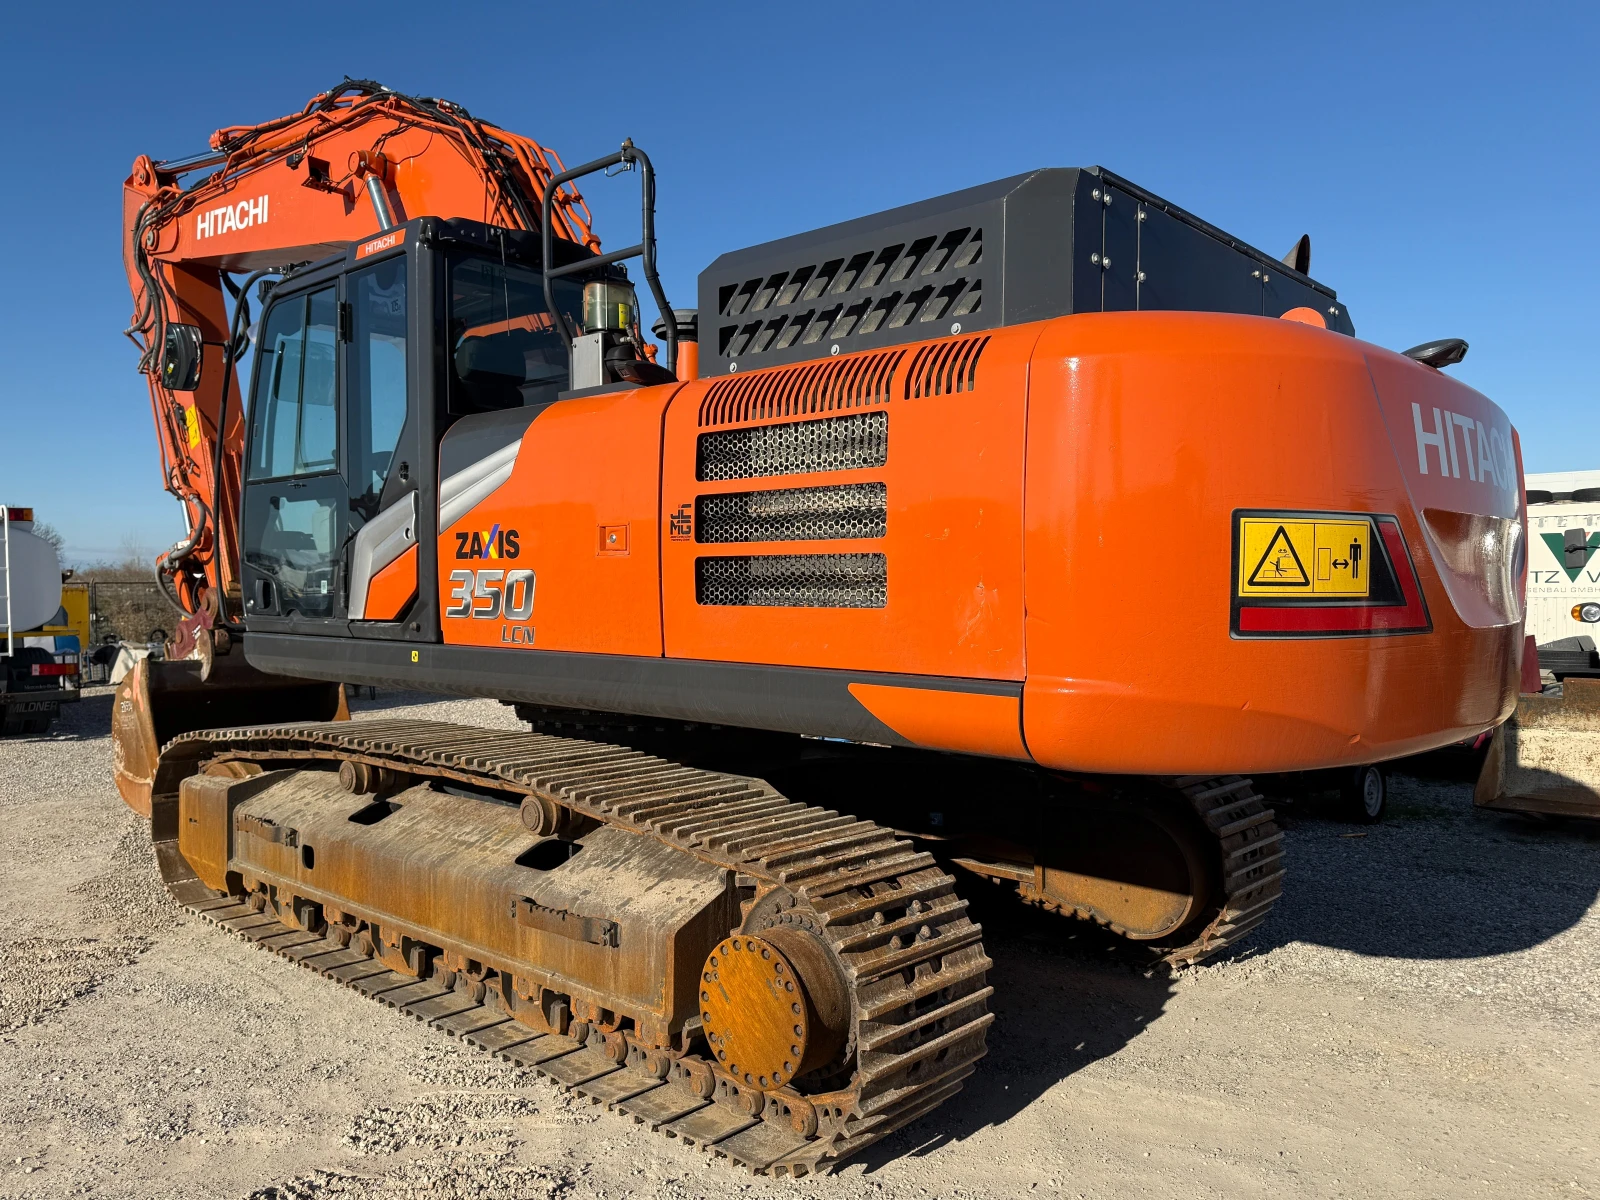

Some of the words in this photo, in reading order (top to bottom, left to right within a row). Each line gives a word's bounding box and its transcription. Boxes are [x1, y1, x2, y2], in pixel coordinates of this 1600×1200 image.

[196, 195, 269, 240] HITACHI
[365, 235, 395, 255] HITACHI
[1411, 402, 1517, 492] HITACH
[455, 523, 520, 560] ZAXIS
[446, 569, 536, 621] 350
[501, 624, 535, 645] LCN
[8, 701, 58, 713] MILDNER
